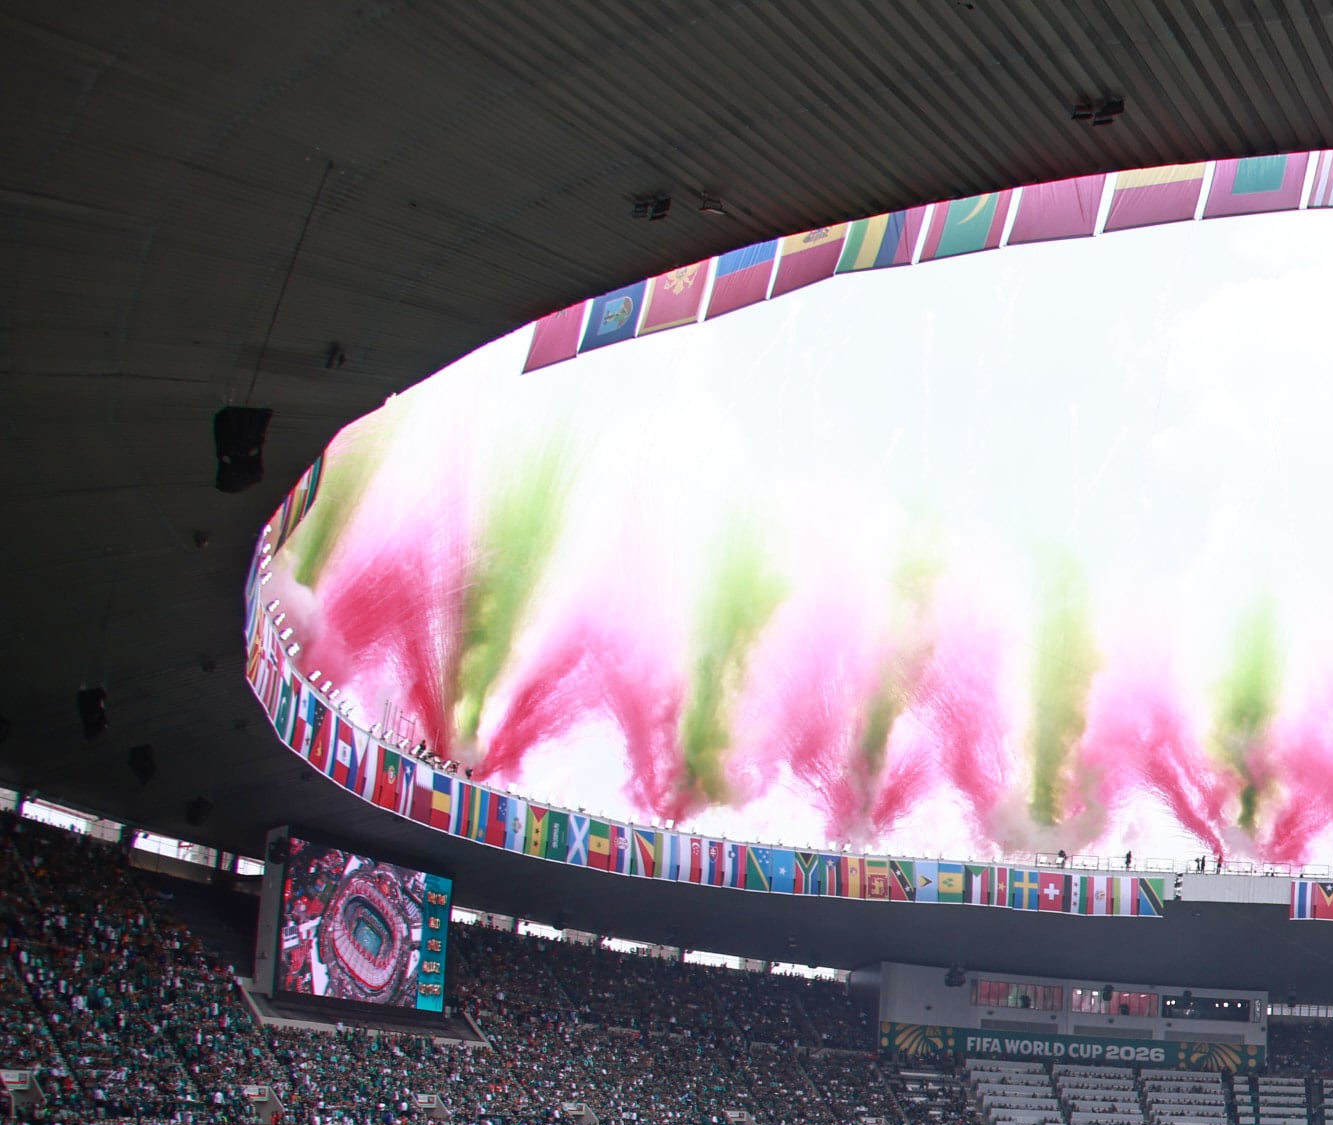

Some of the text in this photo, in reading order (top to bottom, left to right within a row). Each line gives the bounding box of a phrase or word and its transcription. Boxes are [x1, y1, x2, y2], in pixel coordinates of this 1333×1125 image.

[967, 1036, 1165, 1062] FIFA WORLD CUP 2026
